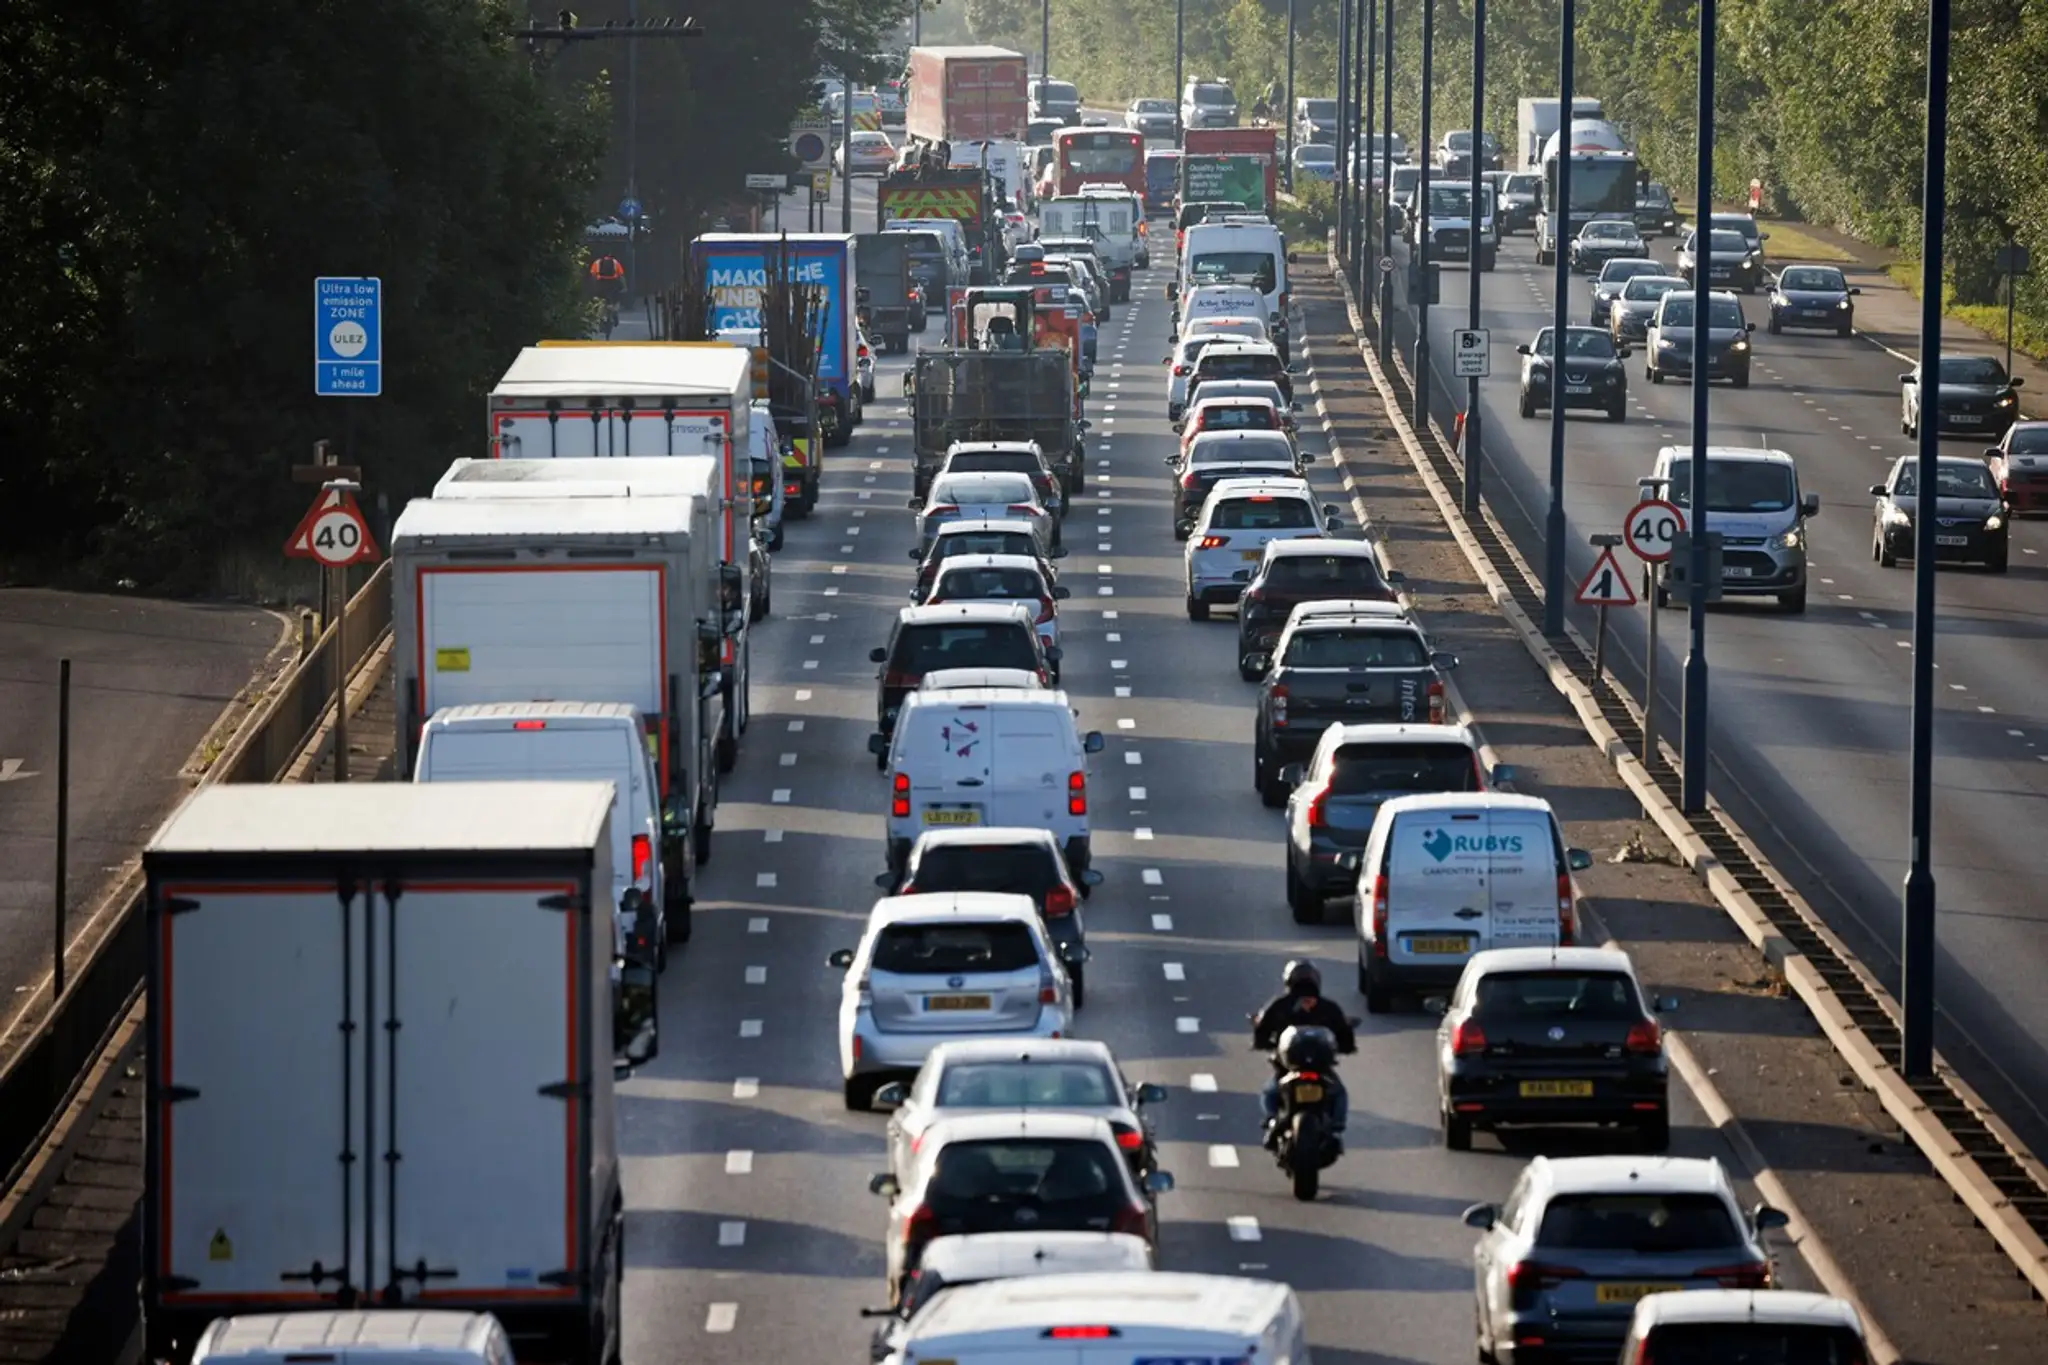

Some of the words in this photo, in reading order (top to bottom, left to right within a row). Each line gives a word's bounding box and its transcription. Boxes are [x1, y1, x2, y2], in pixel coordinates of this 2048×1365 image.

[321, 284, 351, 294] Ultra
[354, 284, 375, 294] low
[323, 297, 373, 306] emission
[331, 308, 365, 318] ZONE
[334, 334, 363, 344] ULEZ
[332, 367, 338, 377] 1
[341, 367, 365, 377] mile
[331, 379, 365, 389] ahead
[1633, 517, 1677, 543] 40
[315, 523, 358, 550] 40
[1454, 835, 1523, 853] RUBYS
[1422, 867, 1475, 876] CARPENTRY
